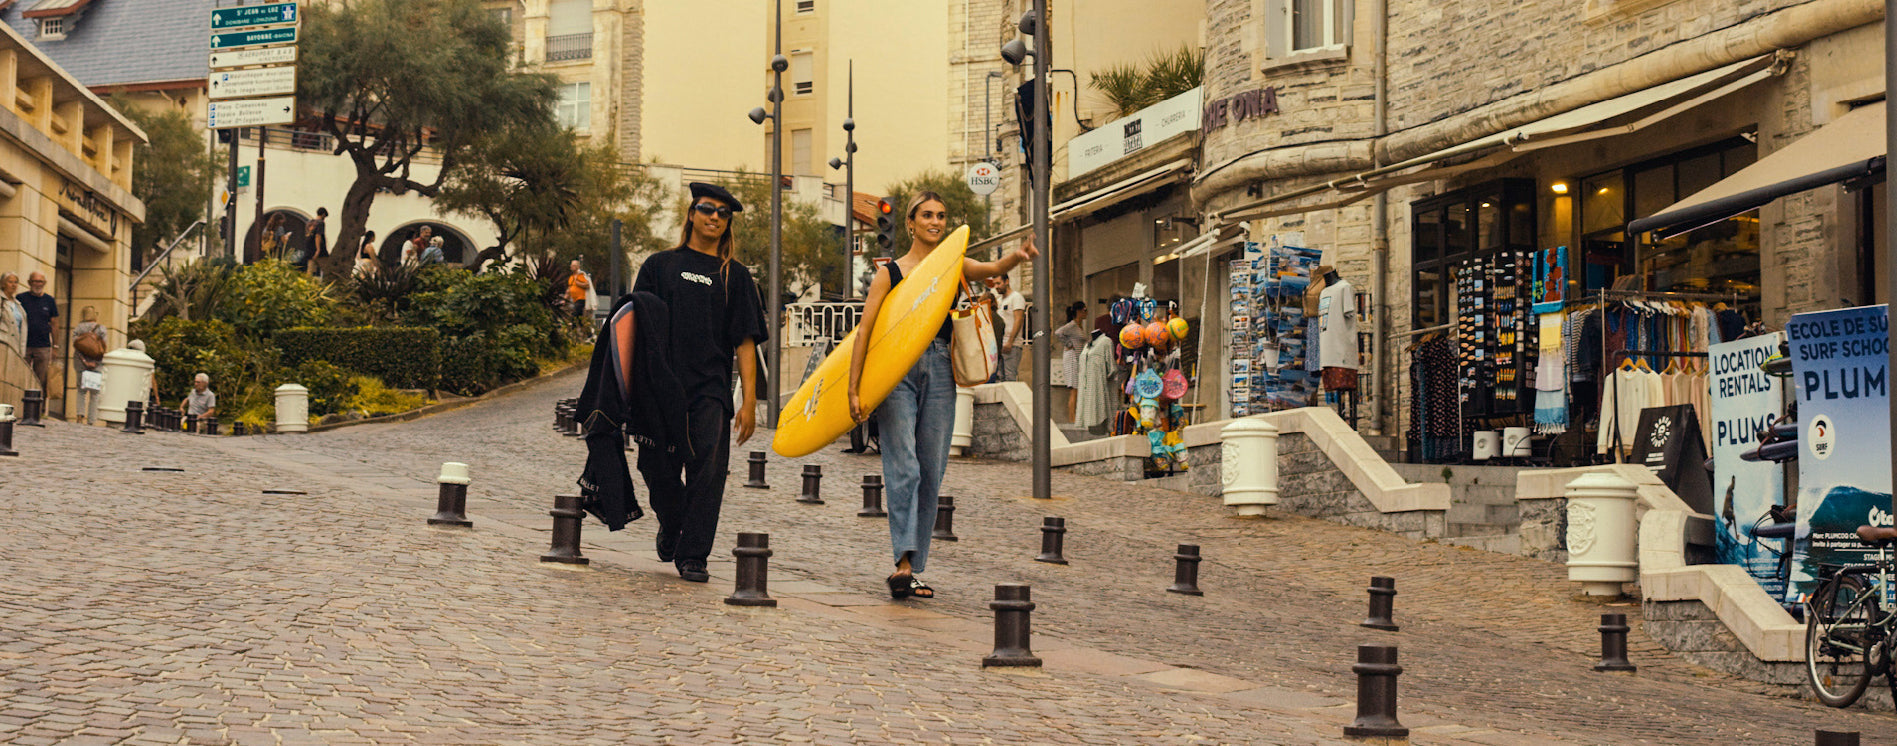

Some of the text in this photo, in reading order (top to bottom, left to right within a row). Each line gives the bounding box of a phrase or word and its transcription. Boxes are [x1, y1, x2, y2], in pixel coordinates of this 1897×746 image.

[244, 7, 259, 15] JEAN
[1232, 86, 1279, 122] ONA
[971, 177, 997, 185] HSBC
[1789, 320, 1841, 340] ECOLE
[1843, 317, 1866, 336] DE
[1714, 345, 1773, 375] LOCATION
[1800, 341, 1838, 361] SURF
[1719, 372, 1771, 399] RENTALS
[1803, 364, 1886, 401] PLUM
[1815, 443, 1828, 451] SURF
